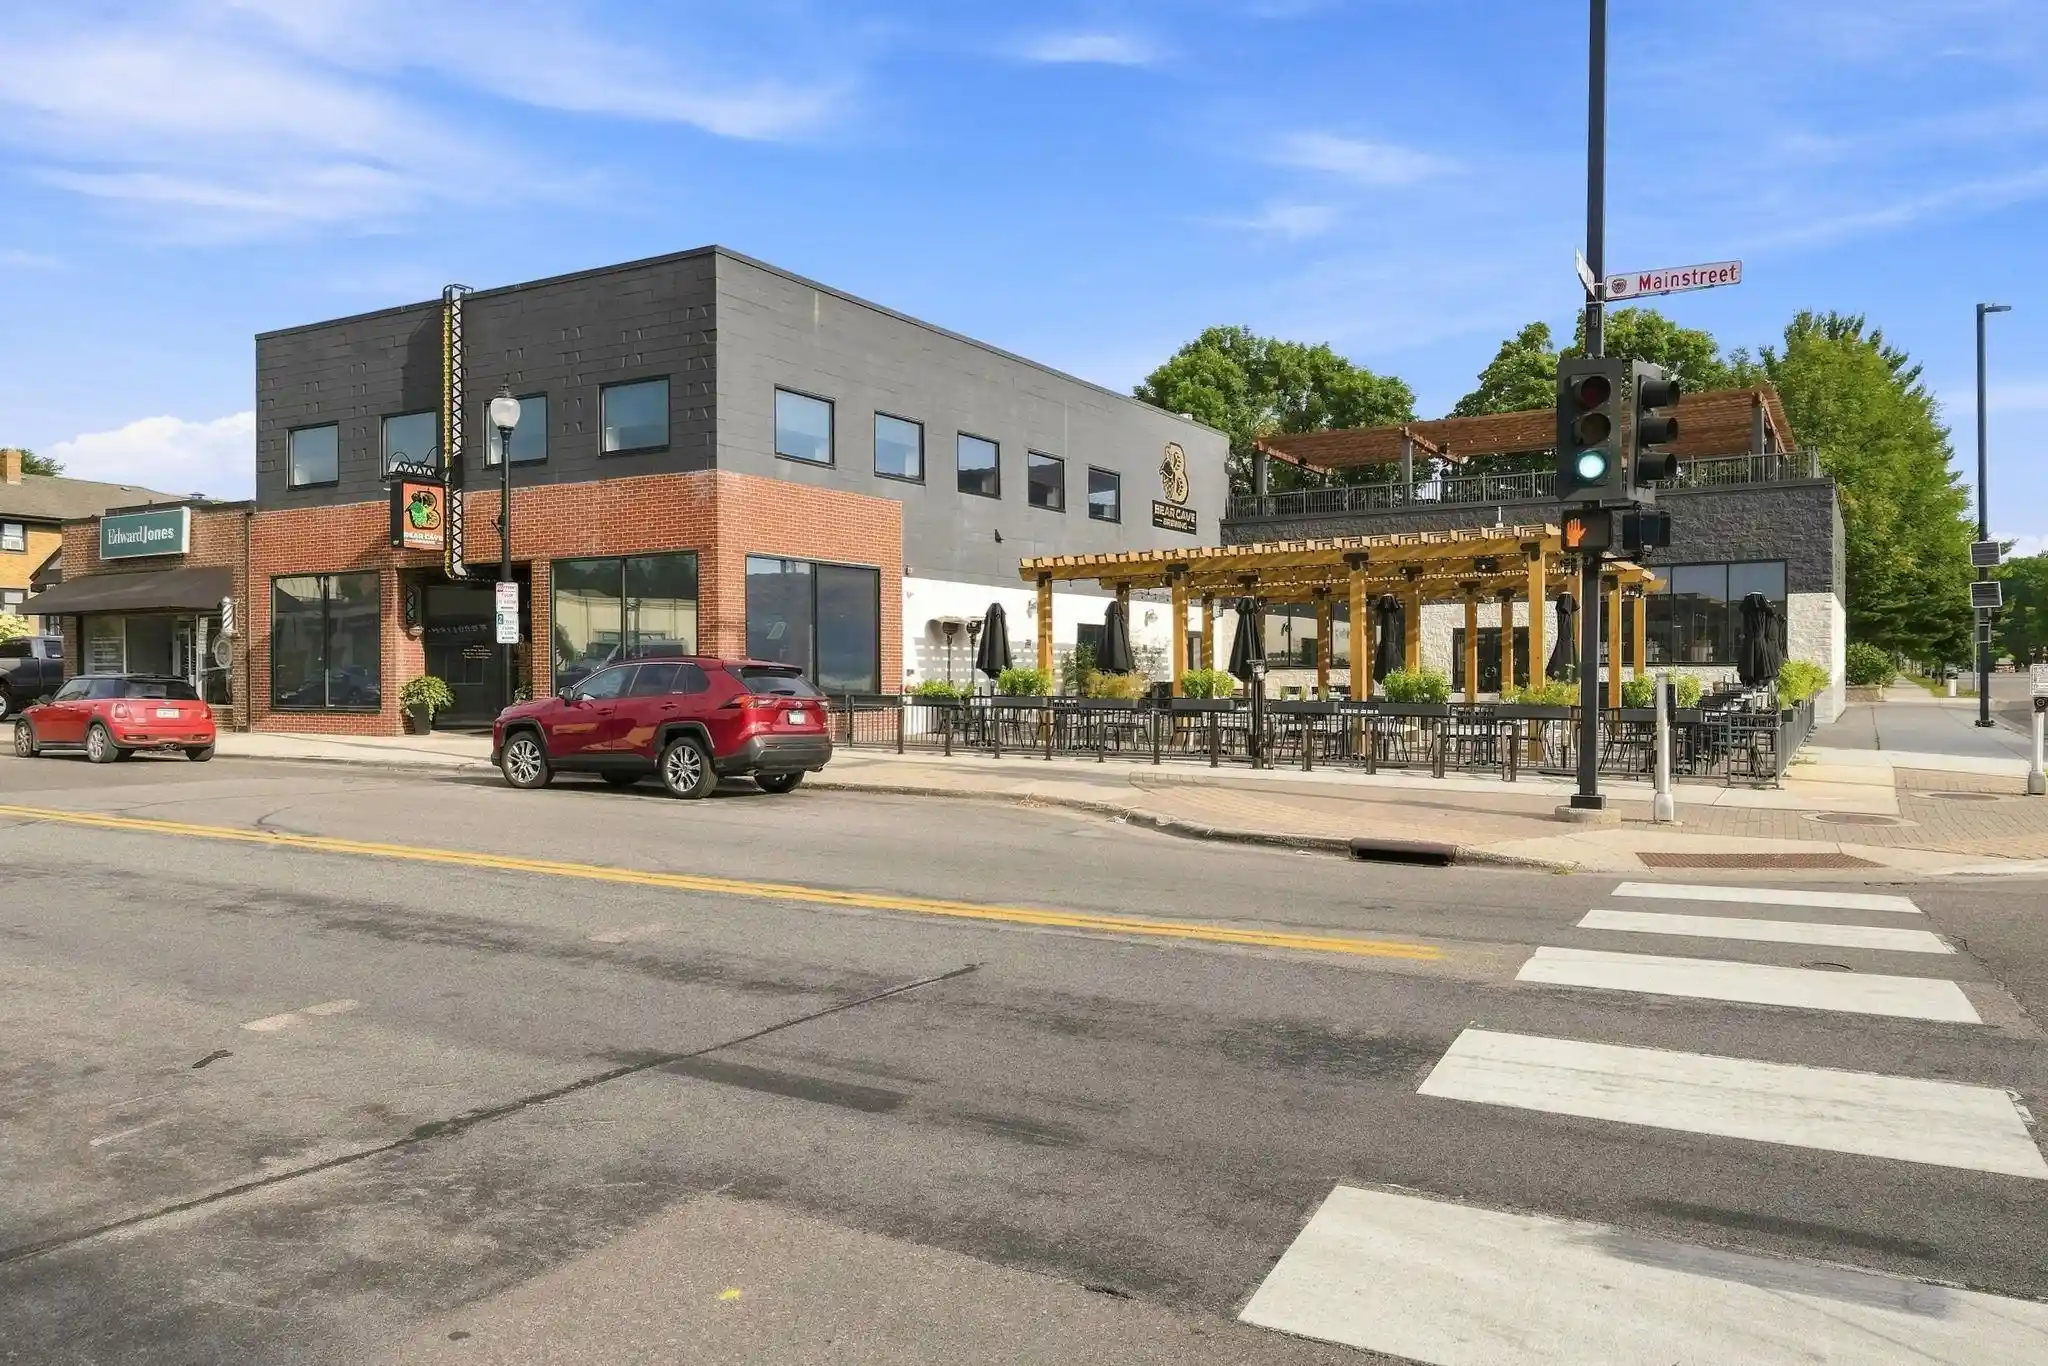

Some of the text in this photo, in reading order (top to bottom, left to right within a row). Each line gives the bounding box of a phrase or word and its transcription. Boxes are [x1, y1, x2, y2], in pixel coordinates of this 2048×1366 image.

[1639, 265, 1737, 292] Mainstreet
[1154, 503, 1196, 523] BEAR CAVE
